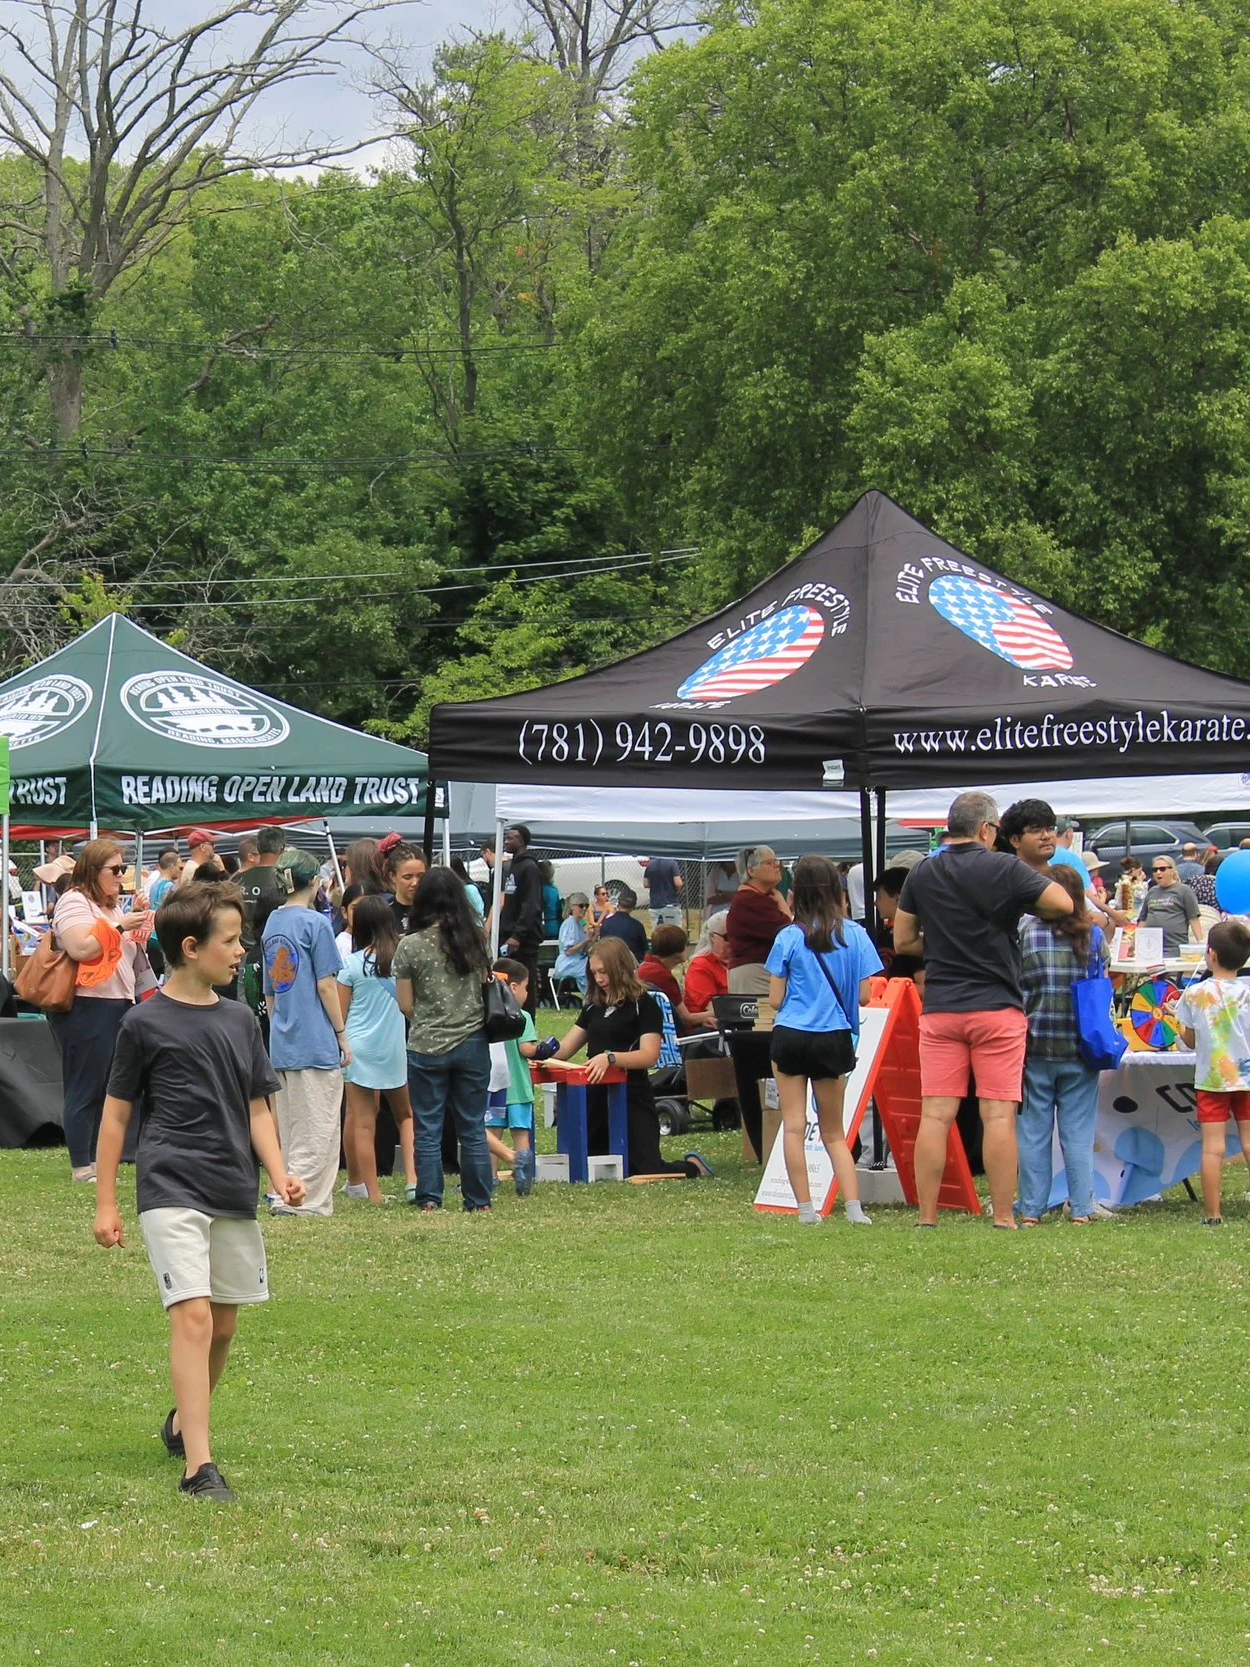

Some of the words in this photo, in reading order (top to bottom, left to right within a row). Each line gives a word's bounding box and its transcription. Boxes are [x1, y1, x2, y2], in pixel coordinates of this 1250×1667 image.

[895, 562, 924, 604] ELITE
[920, 556, 1053, 616] FREESTYLE
[707, 600, 777, 650] ELITE
[781, 583, 850, 637] FREESTYLE
[518, 719, 604, 765] (781)
[615, 721, 766, 764] 942-9898
[9, 777, 67, 805] TRUST
[121, 775, 218, 804] READING
[223, 775, 287, 804] OPEN
[287, 776, 349, 804] LAND
[353, 776, 420, 805] TRUST
